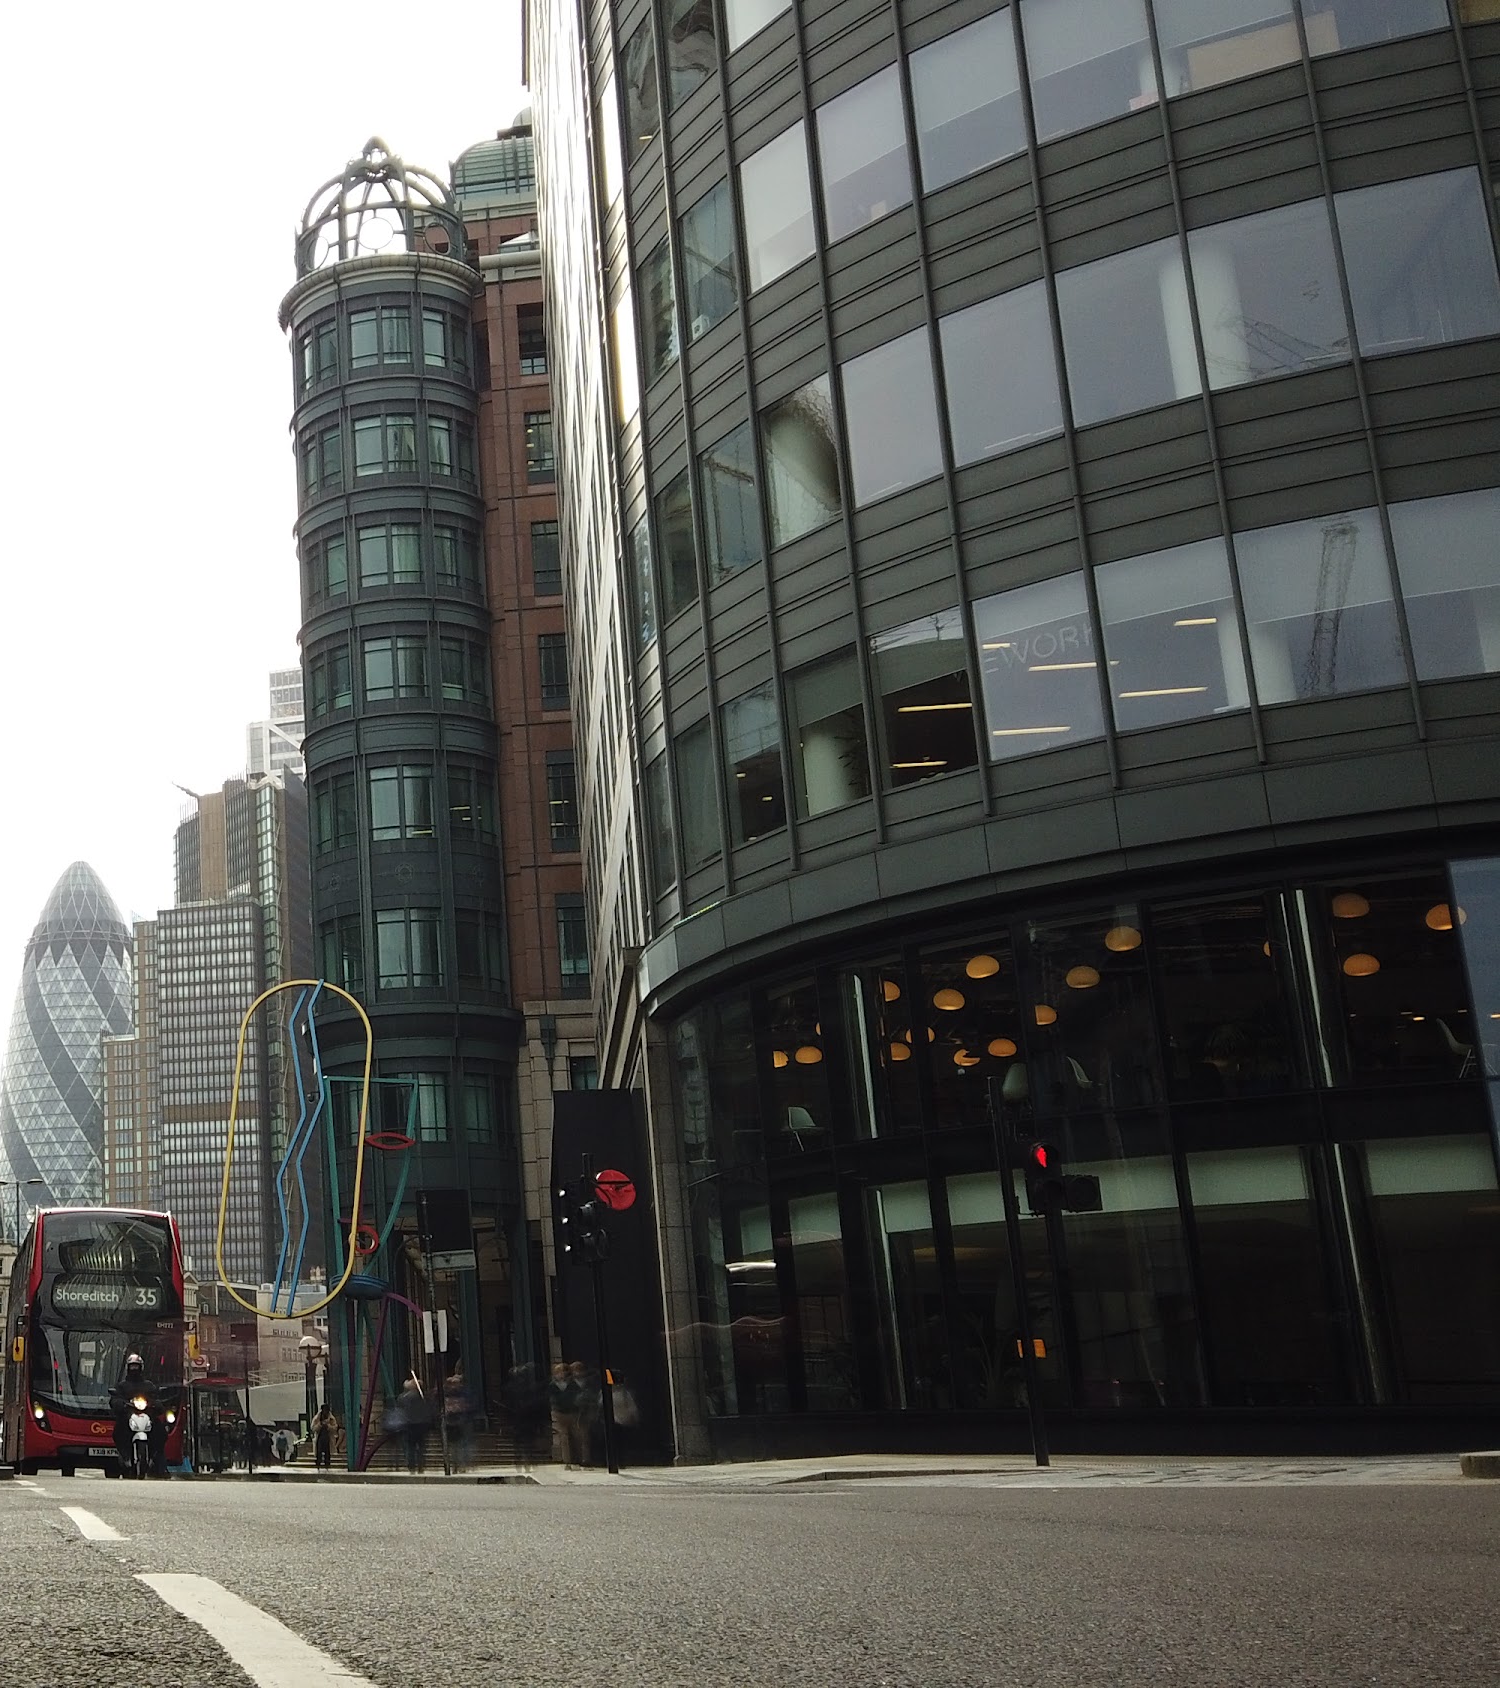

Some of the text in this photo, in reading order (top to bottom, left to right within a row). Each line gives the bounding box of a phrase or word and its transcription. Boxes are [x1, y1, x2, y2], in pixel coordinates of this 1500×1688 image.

[55, 1287, 157, 1306] Shoreditch 35
[90, 1421, 107, 1434] Go
